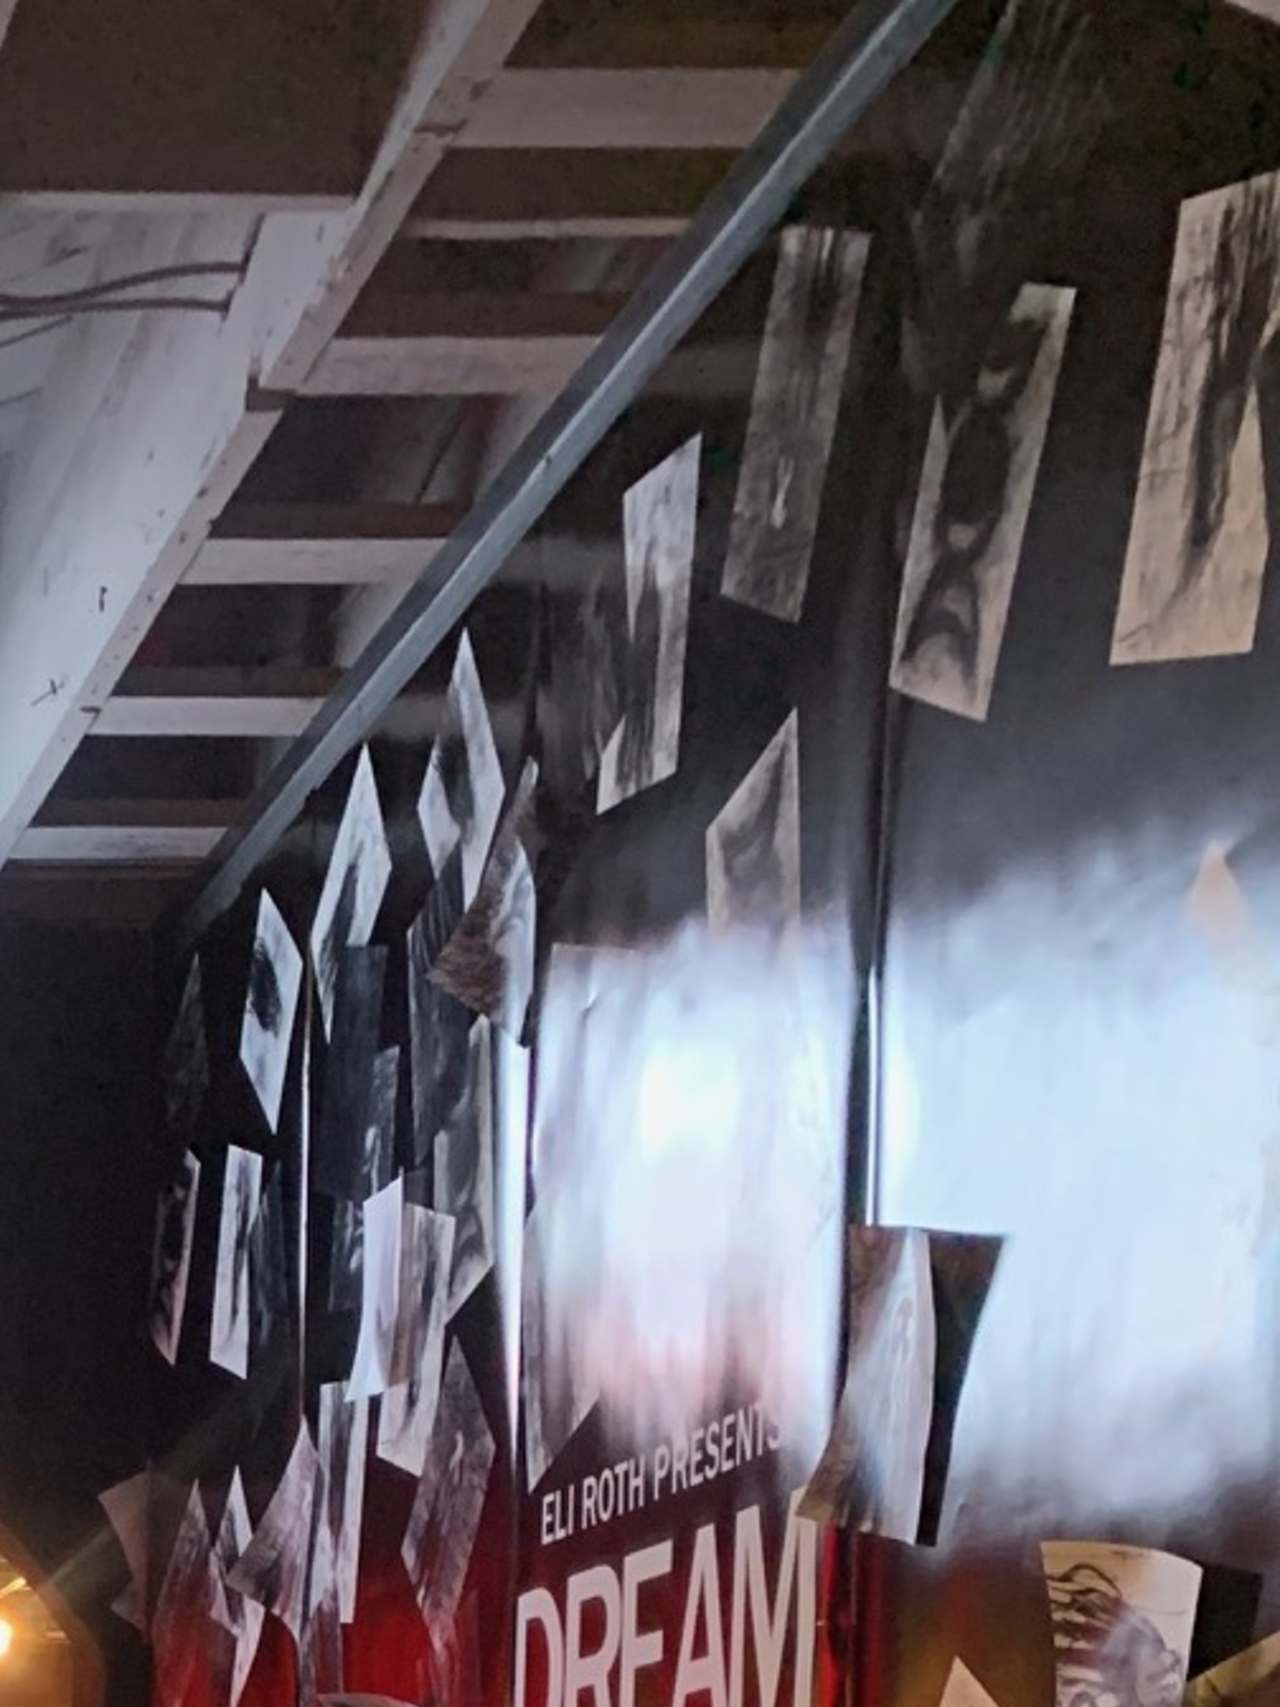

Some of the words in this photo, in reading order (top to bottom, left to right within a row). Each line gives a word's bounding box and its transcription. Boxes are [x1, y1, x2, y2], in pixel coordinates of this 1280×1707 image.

[541, 1485, 576, 1545] ELI
[581, 1456, 644, 1530] ROTH
[653, 1403, 783, 1501] PRESENTS
